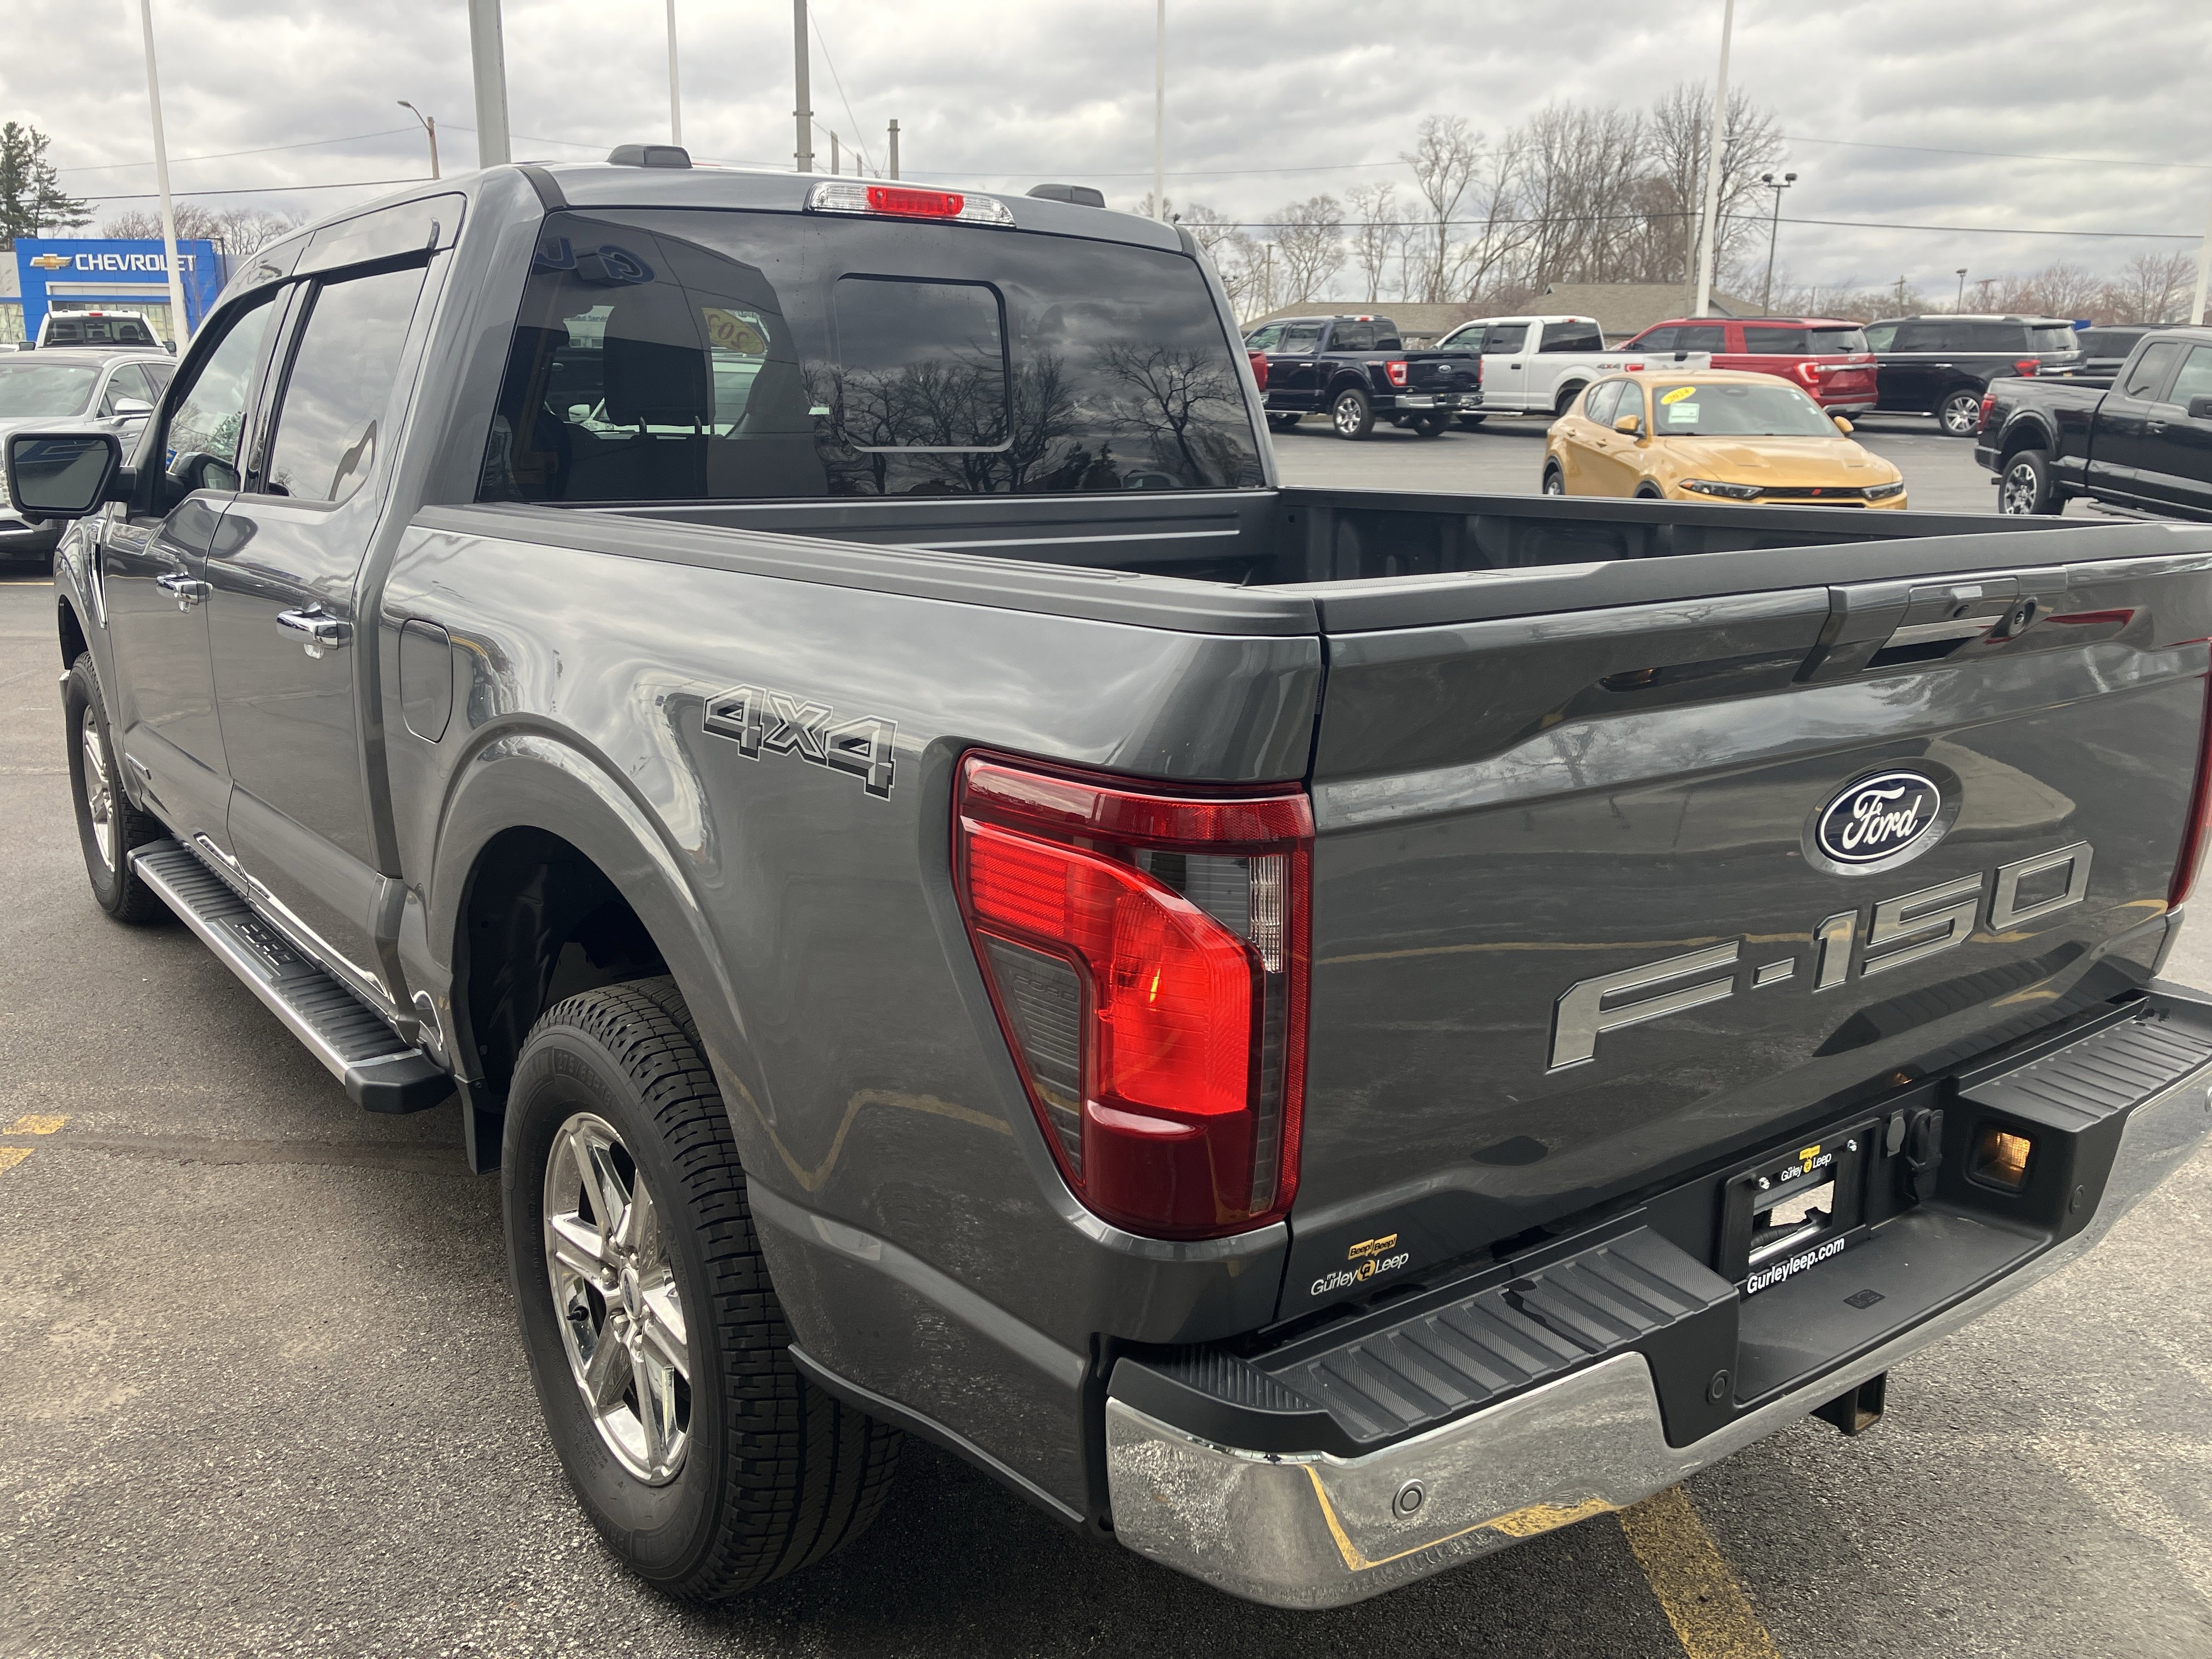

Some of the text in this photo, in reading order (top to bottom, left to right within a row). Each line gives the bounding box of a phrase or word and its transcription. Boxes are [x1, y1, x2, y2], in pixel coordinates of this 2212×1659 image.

[75, 253, 196, 272] CHEVROLET
[1842, 786, 1922, 850] Ford
[234, 922, 298, 966] FORD
[1547, 840, 2095, 1074] F-150
[1781, 1165, 1803, 1181] Gurley
[1813, 1153, 1832, 1168] Leep
[1350, 1238, 1396, 1256] Beep! Beep!
[1747, 1238, 1845, 1294] Gurleyleep.com
[1310, 1269, 1358, 1296] Gurley
[1375, 1252, 1409, 1274] Leep
